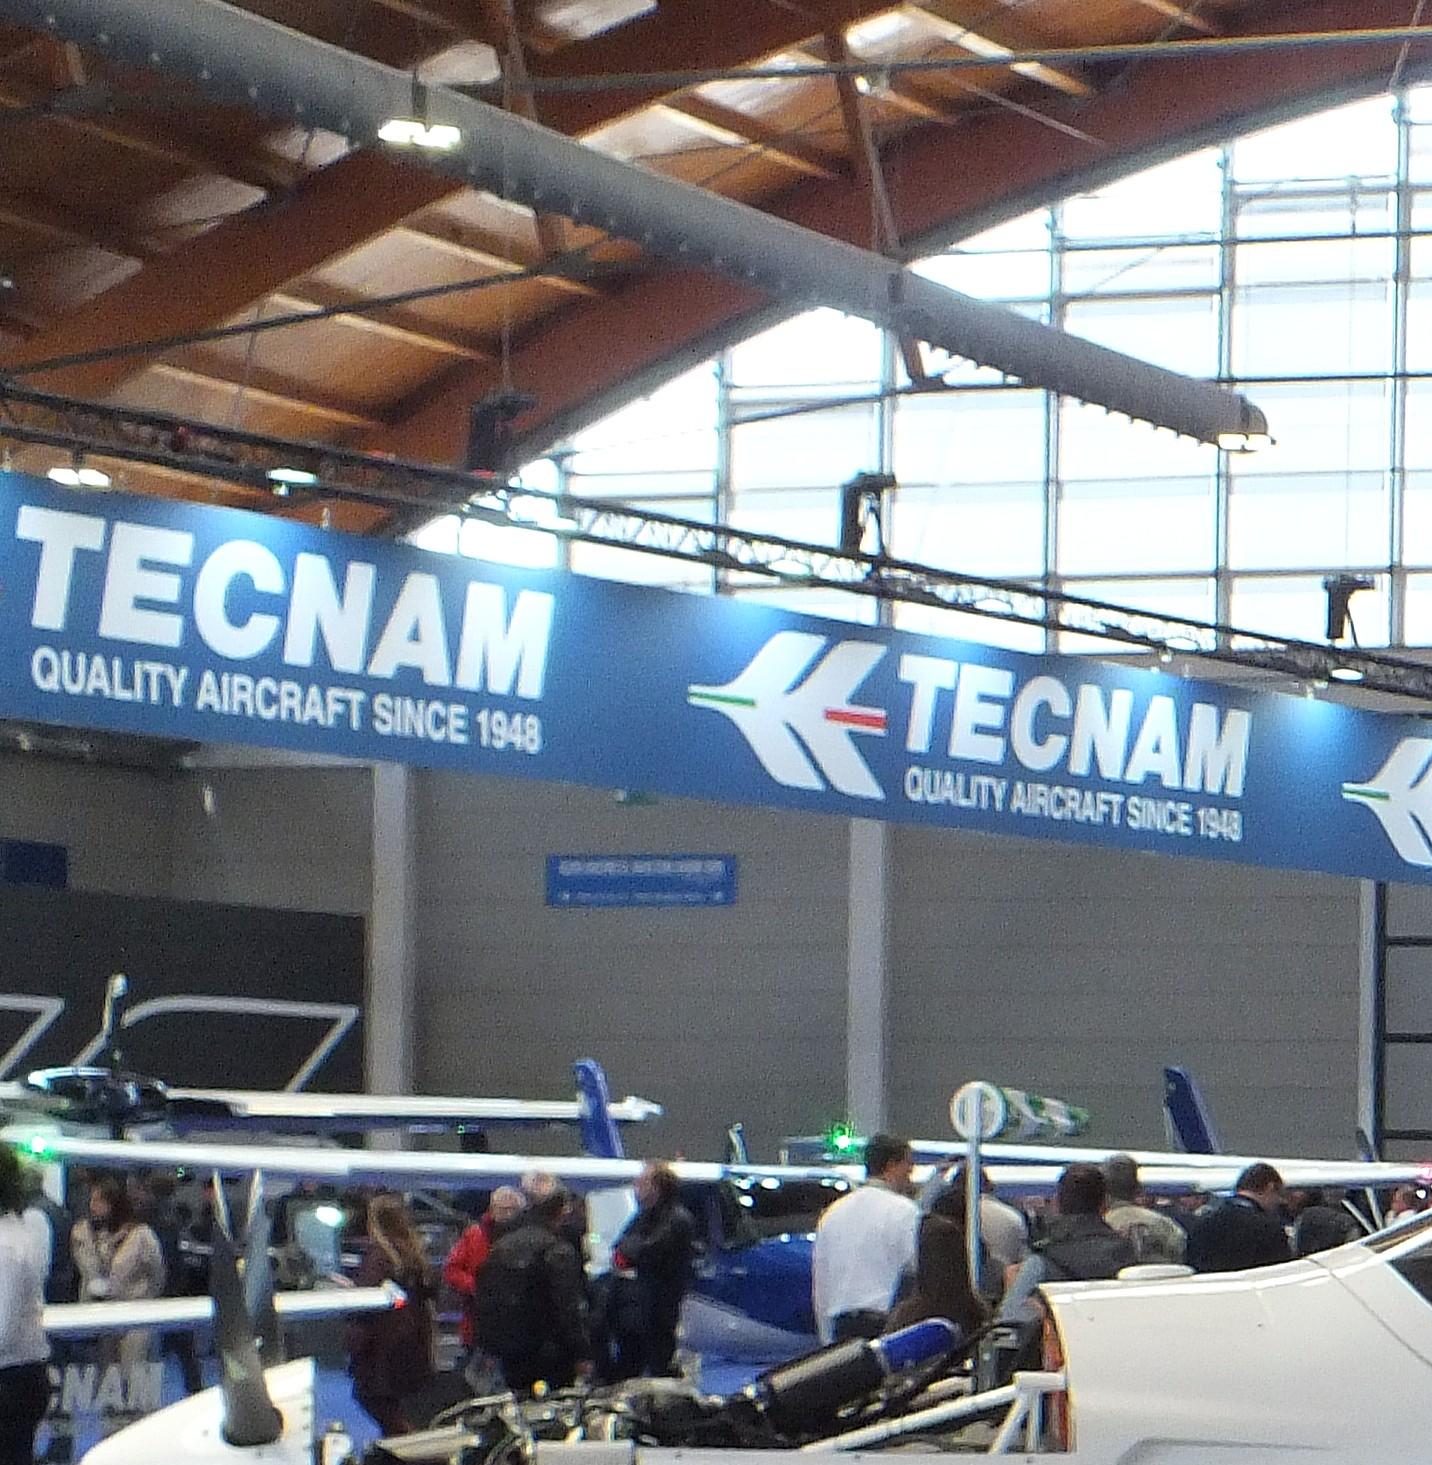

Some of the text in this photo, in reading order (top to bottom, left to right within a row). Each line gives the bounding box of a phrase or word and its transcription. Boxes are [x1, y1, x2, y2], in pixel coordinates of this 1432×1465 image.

[15, 505, 556, 699] TECNAM
[31, 644, 541, 754] QUALITY AIRCRAFT SINCE 1948
[900, 654, 1252, 798] TECNAM
[903, 765, 1243, 842] QUALITY AIRCRAFT SINCE 1948
